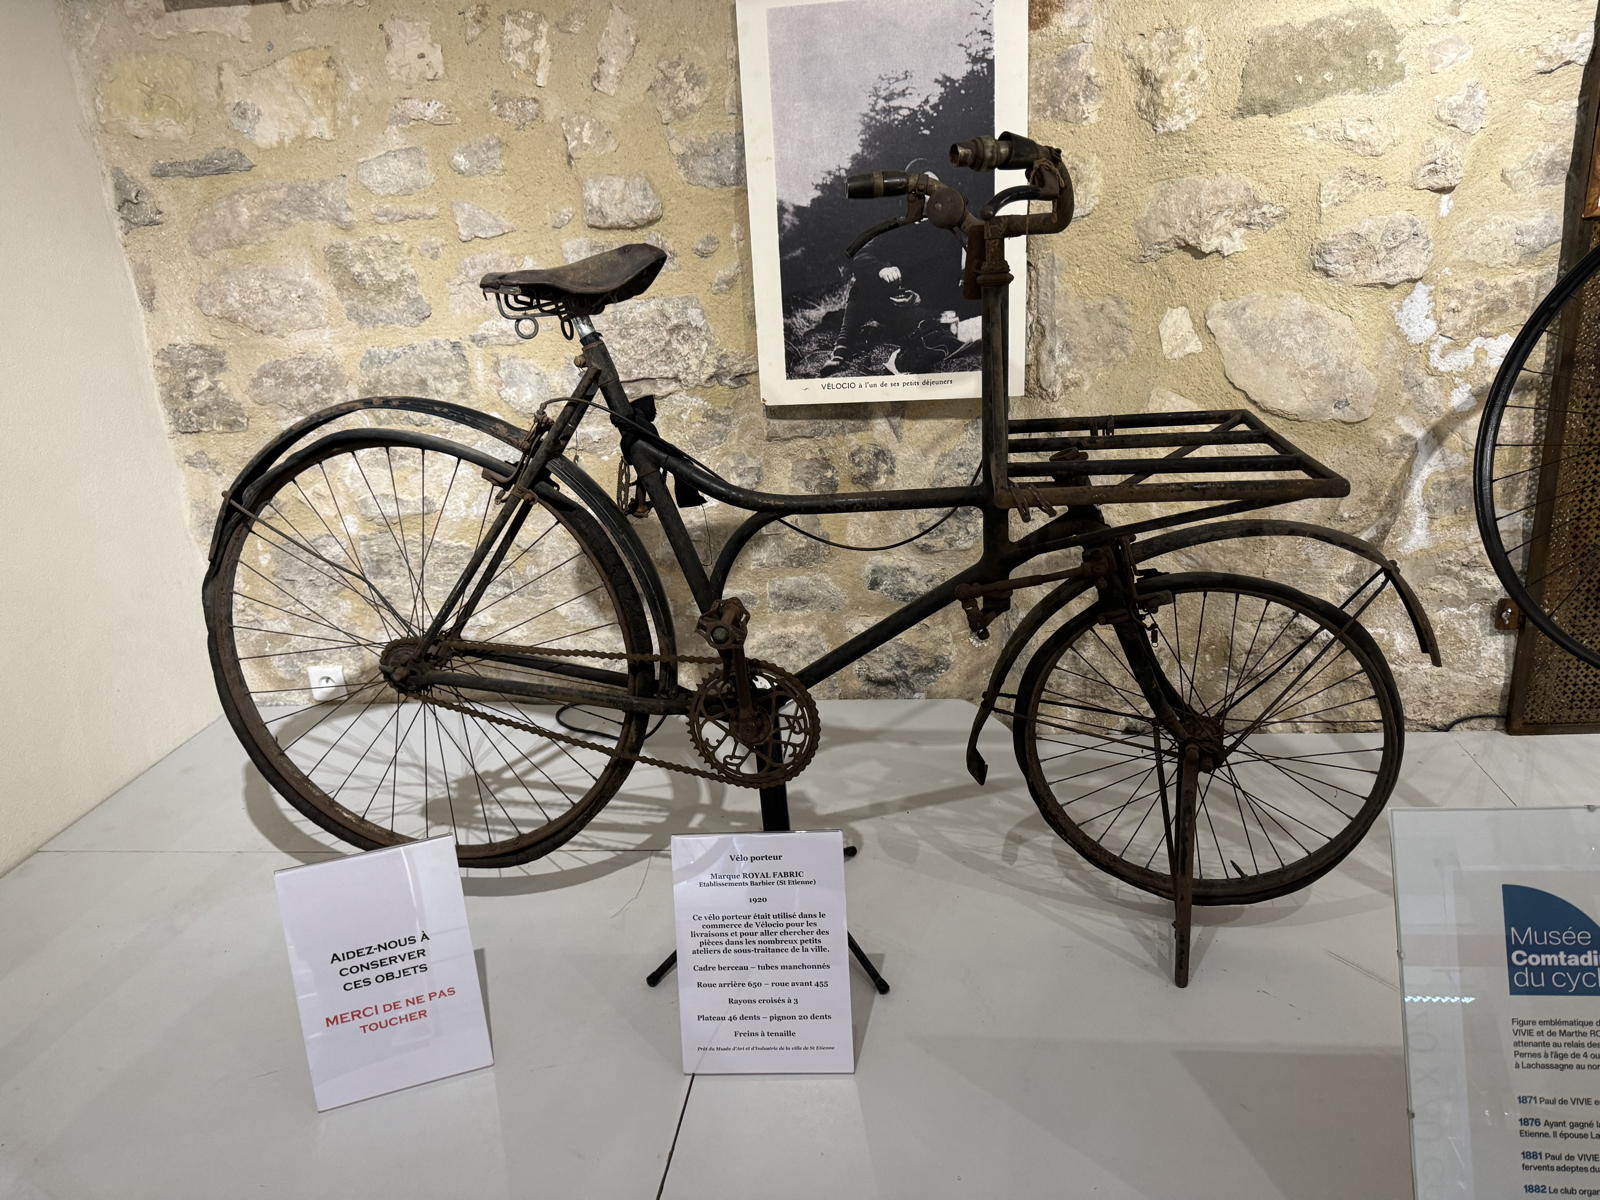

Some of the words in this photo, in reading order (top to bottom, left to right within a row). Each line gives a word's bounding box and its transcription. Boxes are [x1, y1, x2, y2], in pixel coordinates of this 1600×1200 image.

[821, 382, 856, 390] VÉLOCIO
[922, 379, 953, 387] déjeuners
[750, 854, 782, 863] porteur
[710, 873, 740, 881] Marque
[722, 914, 751, 922] porteur
[786, 922, 804, 930] pour
[740, 931, 758, 940] pour
[1511, 927, 1592, 946] Musée
[699, 938, 724, 947] pièces
[800, 938, 822, 946] petits
[330, 936, 416, 964] AIDEZ-NOUS
[420, 931, 430, 942] À
[339, 948, 426, 977] CONSERVER
[1512, 950, 1600, 966] Comtadi
[343, 979, 372, 992] CES
[375, 964, 428, 984] OBJETS
[1514, 968, 1544, 988] du
[325, 1005, 379, 1028] MERCI
[383, 1001, 402, 1013] DE
[406, 995, 424, 1008] NE
[428, 987, 456, 1002] PAS
[360, 1010, 428, 1034] TOUCHER
[728, 1014, 738, 1022] 46
[769, 1014, 796, 1022] pignon
[1512, 1018, 1536, 1028] Figure
[1538, 1018, 1594, 1028] emblématique
[1559, 1030, 1588, 1038] Marthe
[1544, 1051, 1548, 1059] à
[1522, 1062, 1574, 1071] Lachassagne
[1518, 1096, 1538, 1104] 1871
[1519, 1118, 1541, 1126] 1876
[1544, 1120, 1566, 1128] Ayant
[1569, 1120, 1594, 1130] gagné
[1559, 1131, 1588, 1140] épouse
[1521, 1152, 1542, 1160] 1881
[1522, 1163, 1554, 1172] fervents
[1556, 1164, 1588, 1174] adeptes
[1524, 1185, 1546, 1194] 1882
[1549, 1186, 1558, 1194] Le
[1560, 1186, 1577, 1194] club
